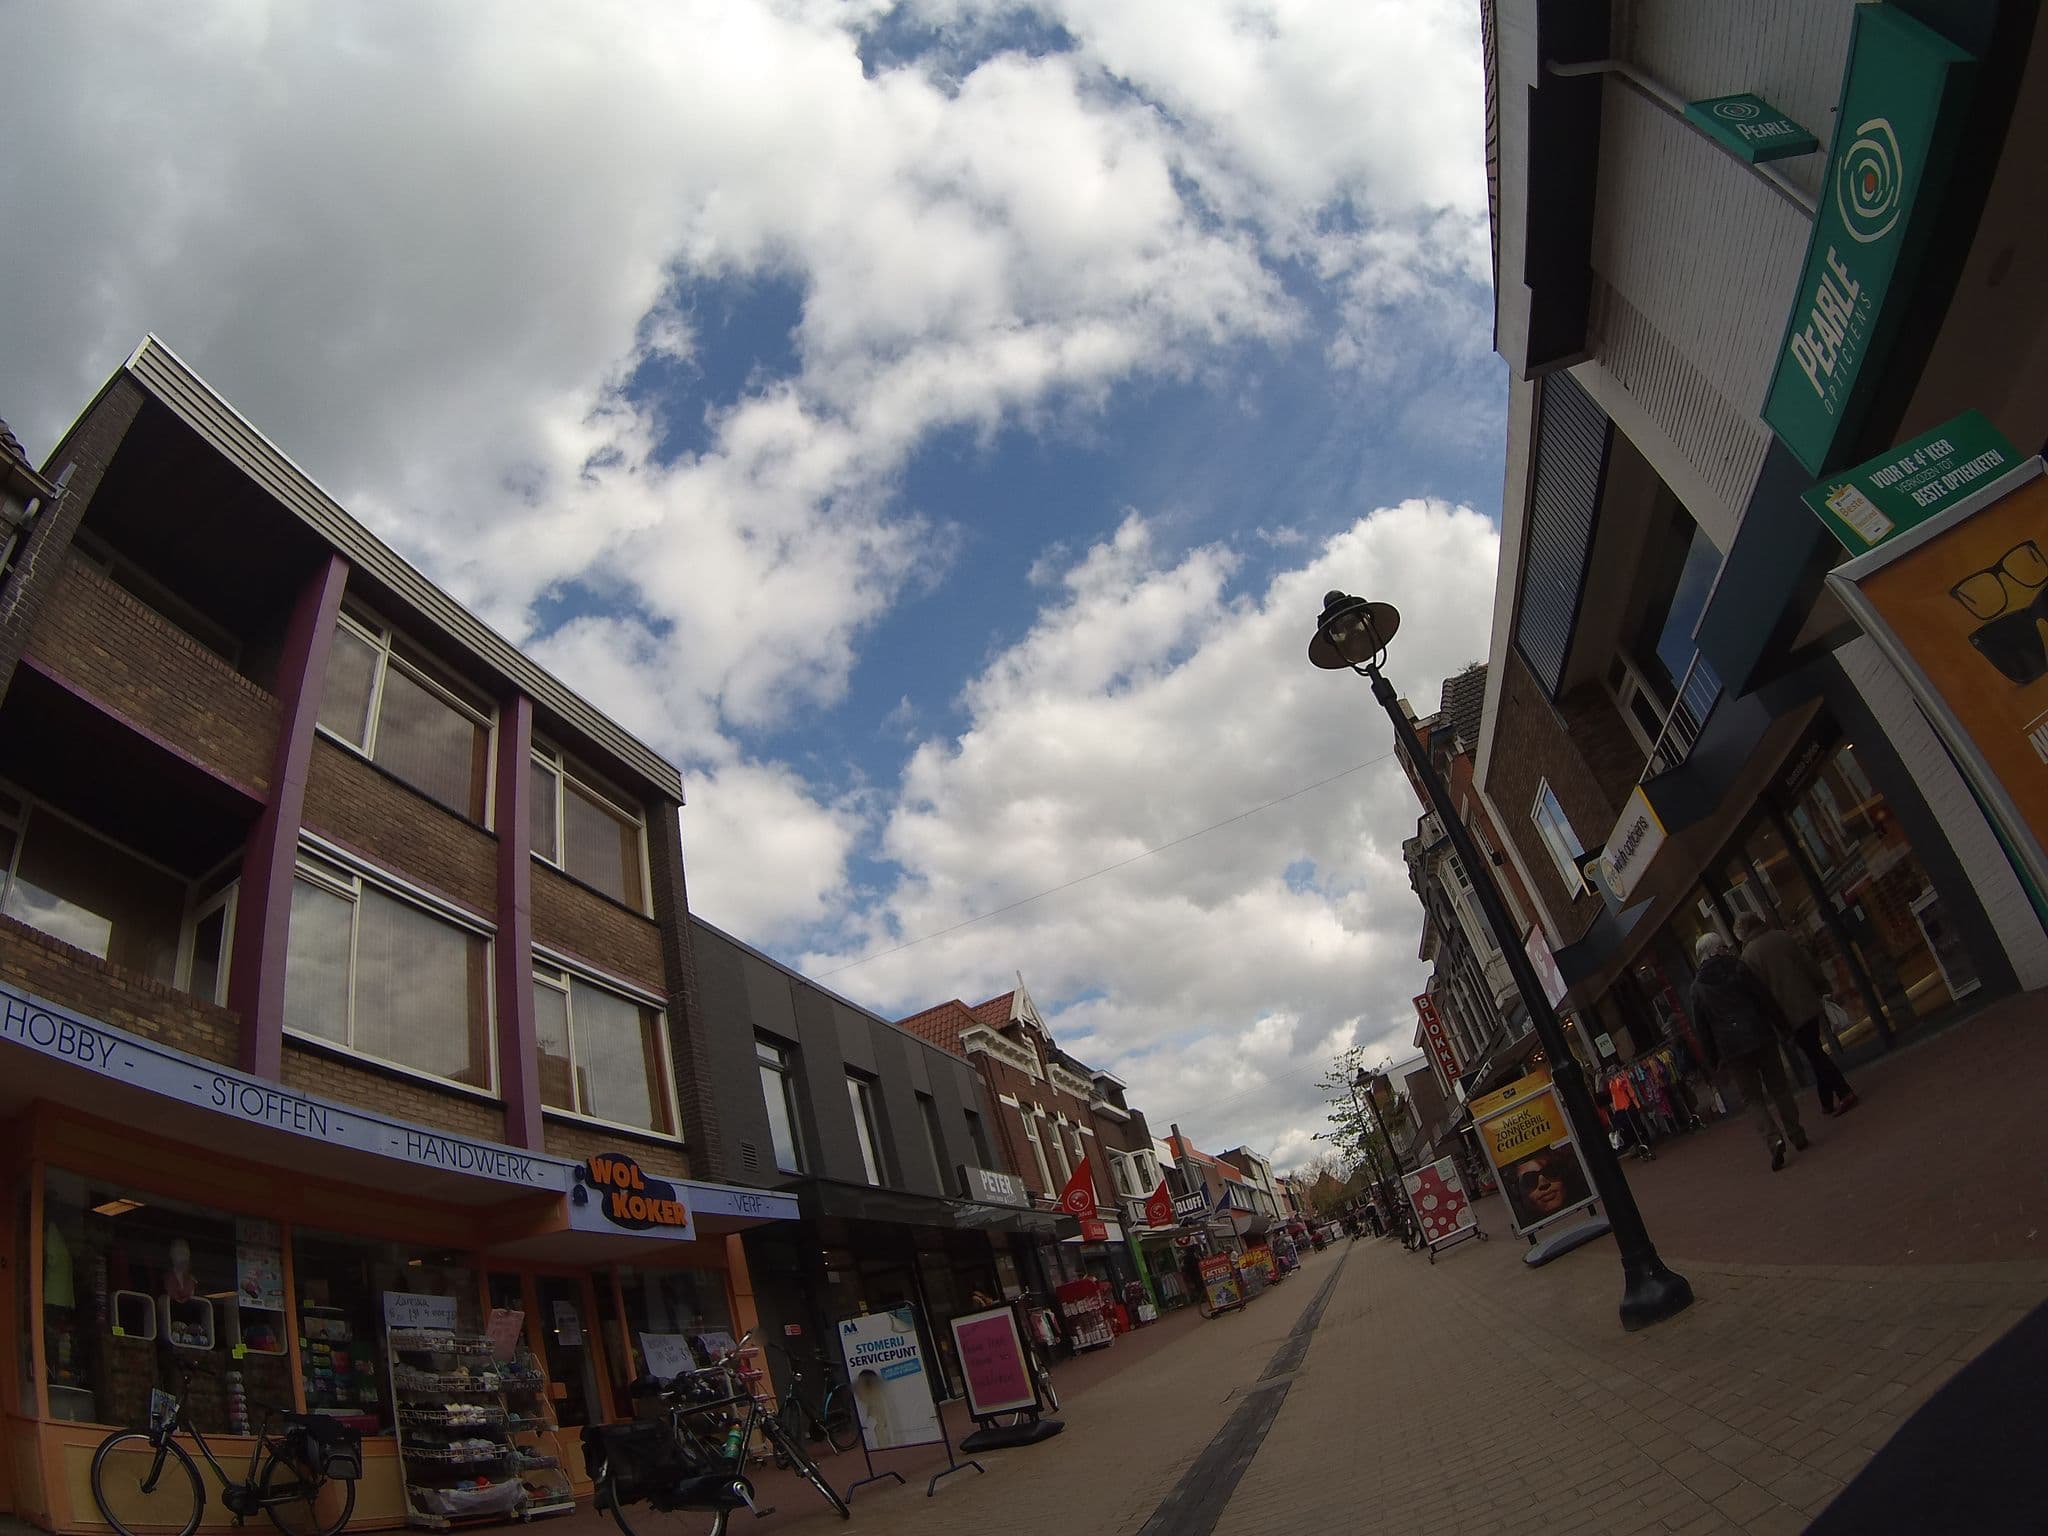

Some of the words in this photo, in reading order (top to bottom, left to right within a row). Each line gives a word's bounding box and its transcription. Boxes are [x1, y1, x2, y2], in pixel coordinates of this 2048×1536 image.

[1736, 119, 1795, 140] PEARLE
[1791, 245, 1860, 398] PEARLE
[1824, 291, 1872, 415] OPTICIENS
[1869, 464, 1905, 488] VOOR
[1898, 457, 1919, 475] DE
[1924, 438, 1955, 461] KEER
[1895, 466, 1941, 493] VERKOZEN
[1939, 458, 1955, 471] TOT
[1910, 480, 1948, 507] BESTE
[1940, 448, 2006, 491] OPTIEKKETEN
[1840, 497, 1865, 517] Beste
[4, 1000, 116, 1068] HOBBY
[211, 1077, 327, 1135] STOFFEN
[1502, 1109, 1531, 1128] MERK
[1497, 1115, 1545, 1142] ZONNEBRIL
[1497, 1121, 1551, 1152] cadeau
[406, 1131, 534, 1182] HANDWERK
[588, 1155, 645, 1191] WOL
[980, 1170, 1014, 1195] PETER
[611, 1191, 688, 1228] KOKER
[733, 1194, 763, 1214] VERF
[1176, 1194, 1203, 1213] BLUFF
[849, 1345, 917, 1368] SERVICEPUNT
[855, 1335, 905, 1354] STOMERIJ
